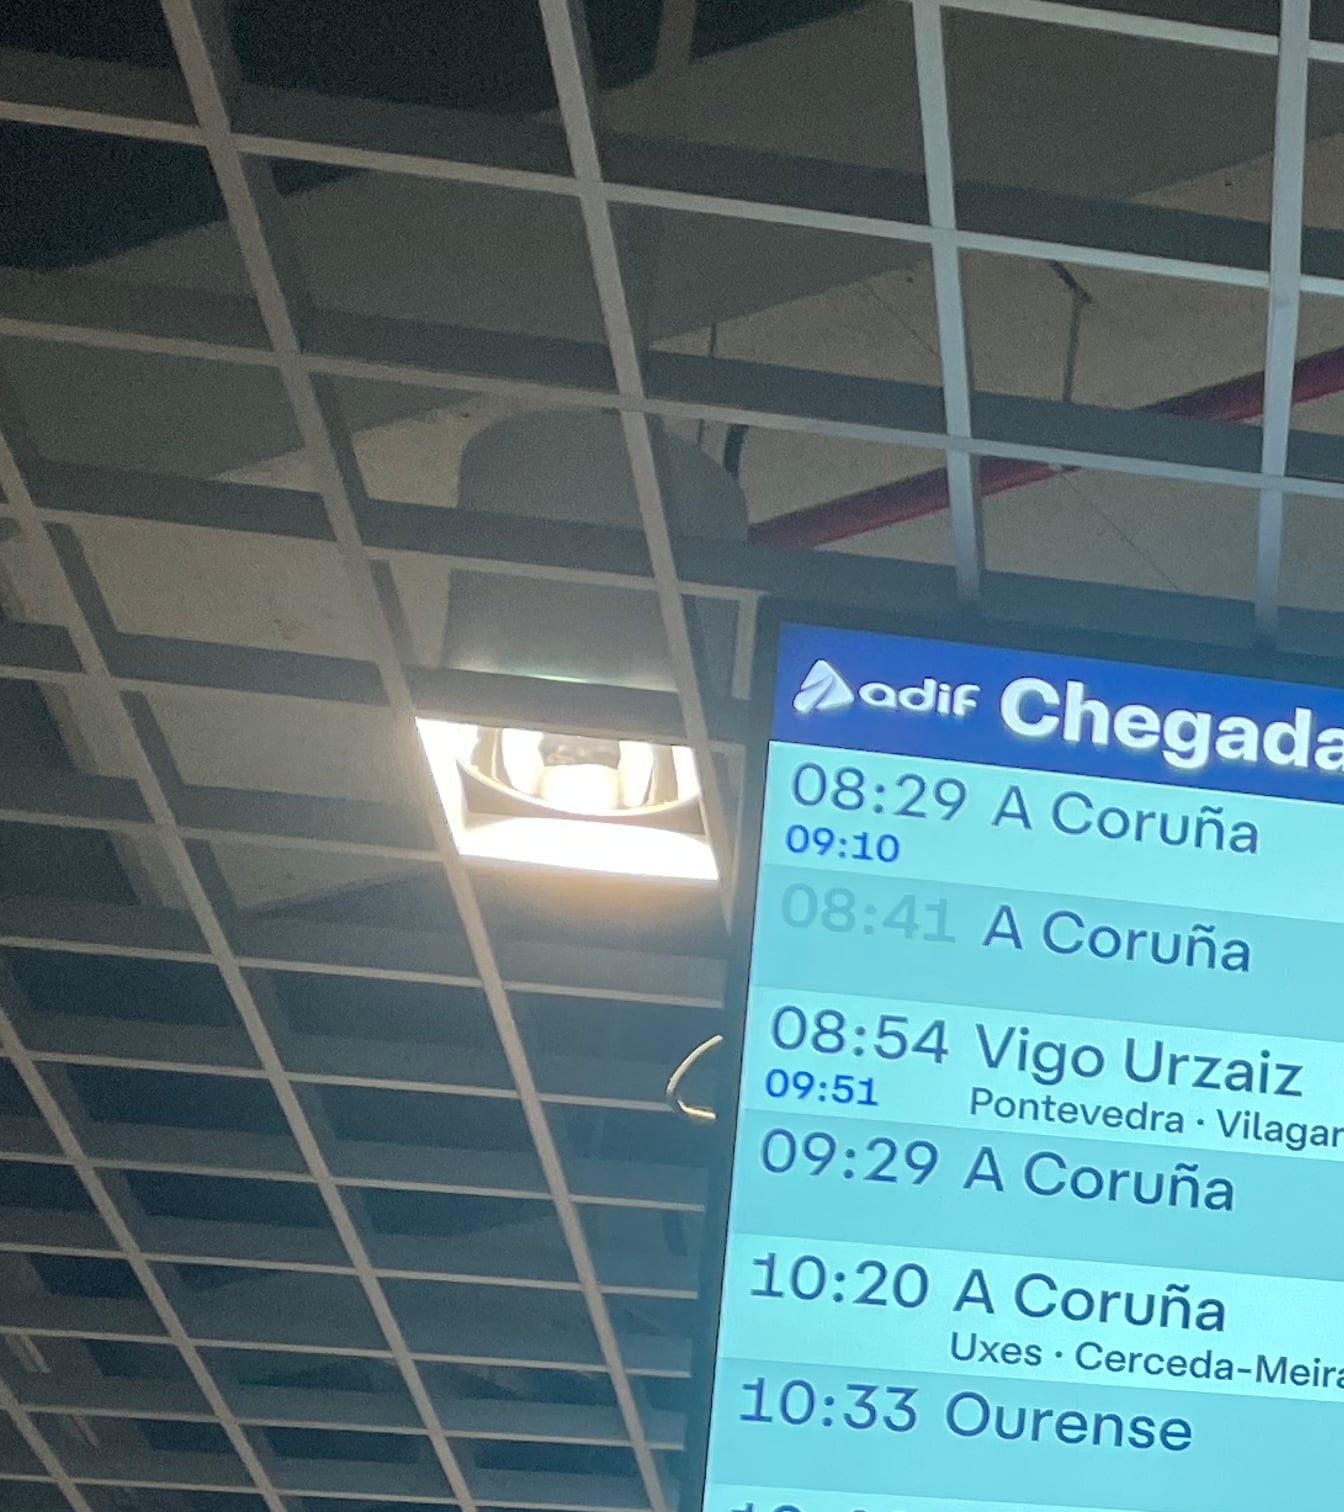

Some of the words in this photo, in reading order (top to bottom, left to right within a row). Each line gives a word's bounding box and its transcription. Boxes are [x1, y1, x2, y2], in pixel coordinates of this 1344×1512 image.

[859, 678, 981, 717] adif
[785, 824, 900, 863] 09:10
[792, 762, 967, 821] 08:29
[991, 785, 1032, 830] A
[1052, 791, 1258, 854] Coruña
[781, 882, 956, 944] 08:41
[982, 904, 1023, 950] A
[1043, 910, 1250, 973] Coruña
[765, 1068, 879, 1107] 09:51
[772, 1005, 949, 1064] 08:54
[975, 1023, 1105, 1086] Vigo
[1125, 1037, 1303, 1097] Urzaiz
[970, 1086, 1184, 1134] Pontevedra
[761, 1128, 938, 1185] 09:29
[963, 1146, 1004, 1192] A
[1024, 1151, 1234, 1212] Coruña
[750, 1252, 929, 1309] 10:20
[953, 1268, 995, 1315] A
[1014, 1272, 1225, 1332] Coruña
[950, 1331, 1042, 1367] Uxes
[740, 1377, 918, 1433] 10:33
[946, 1391, 1192, 1452] Ourense
